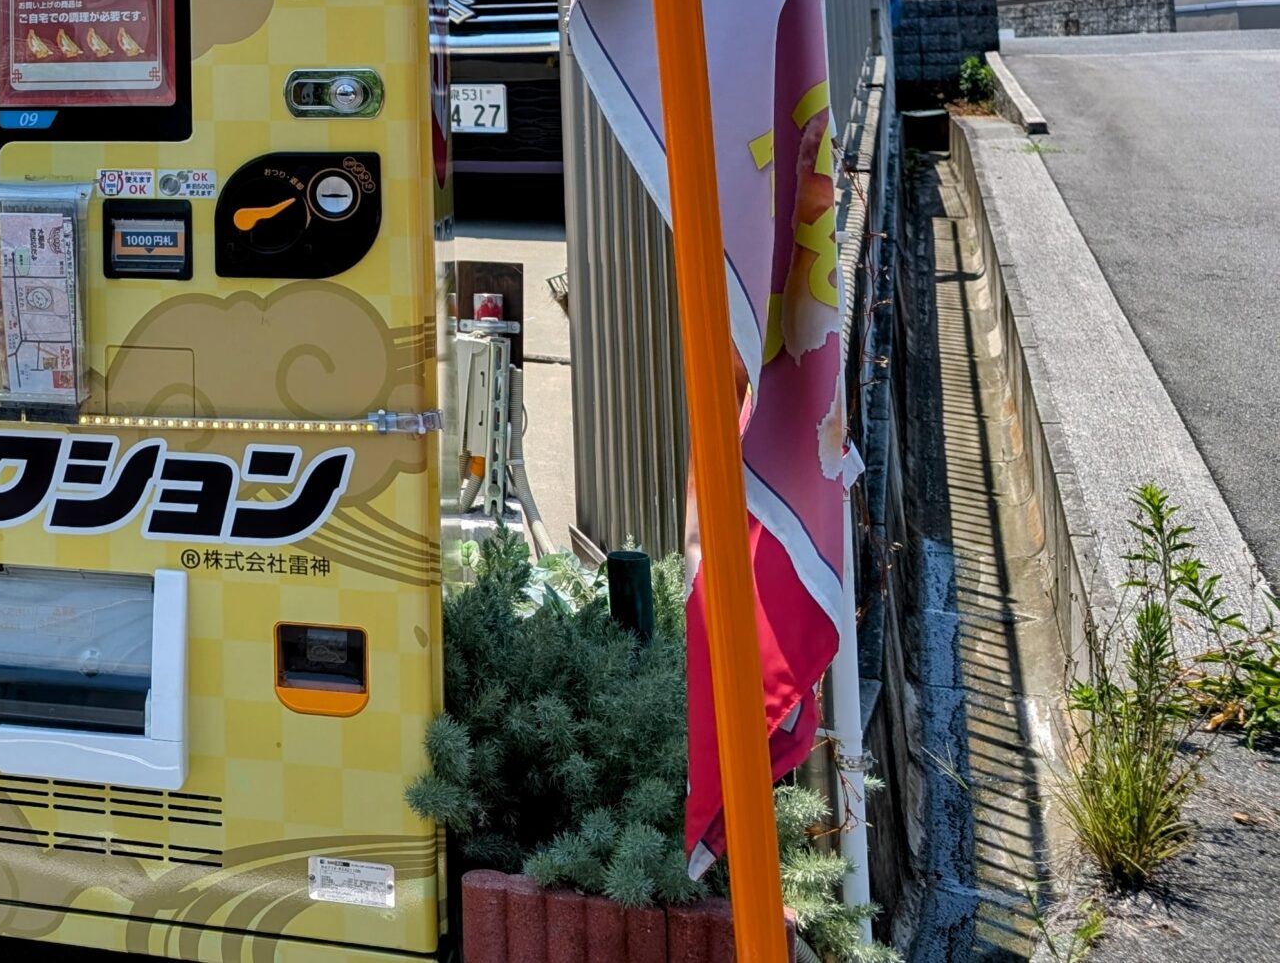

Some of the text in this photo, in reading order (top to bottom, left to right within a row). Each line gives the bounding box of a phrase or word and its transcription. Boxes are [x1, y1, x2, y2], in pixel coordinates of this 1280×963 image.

[18, 11, 147, 24] ご自宅での調理が必要です。
[19, 112, 39, 127] 09
[473, 104, 501, 127] 27
[192, 172, 208, 181] OK
[129, 184, 147, 195] OK
[125, 235, 174, 247] 1000円札
